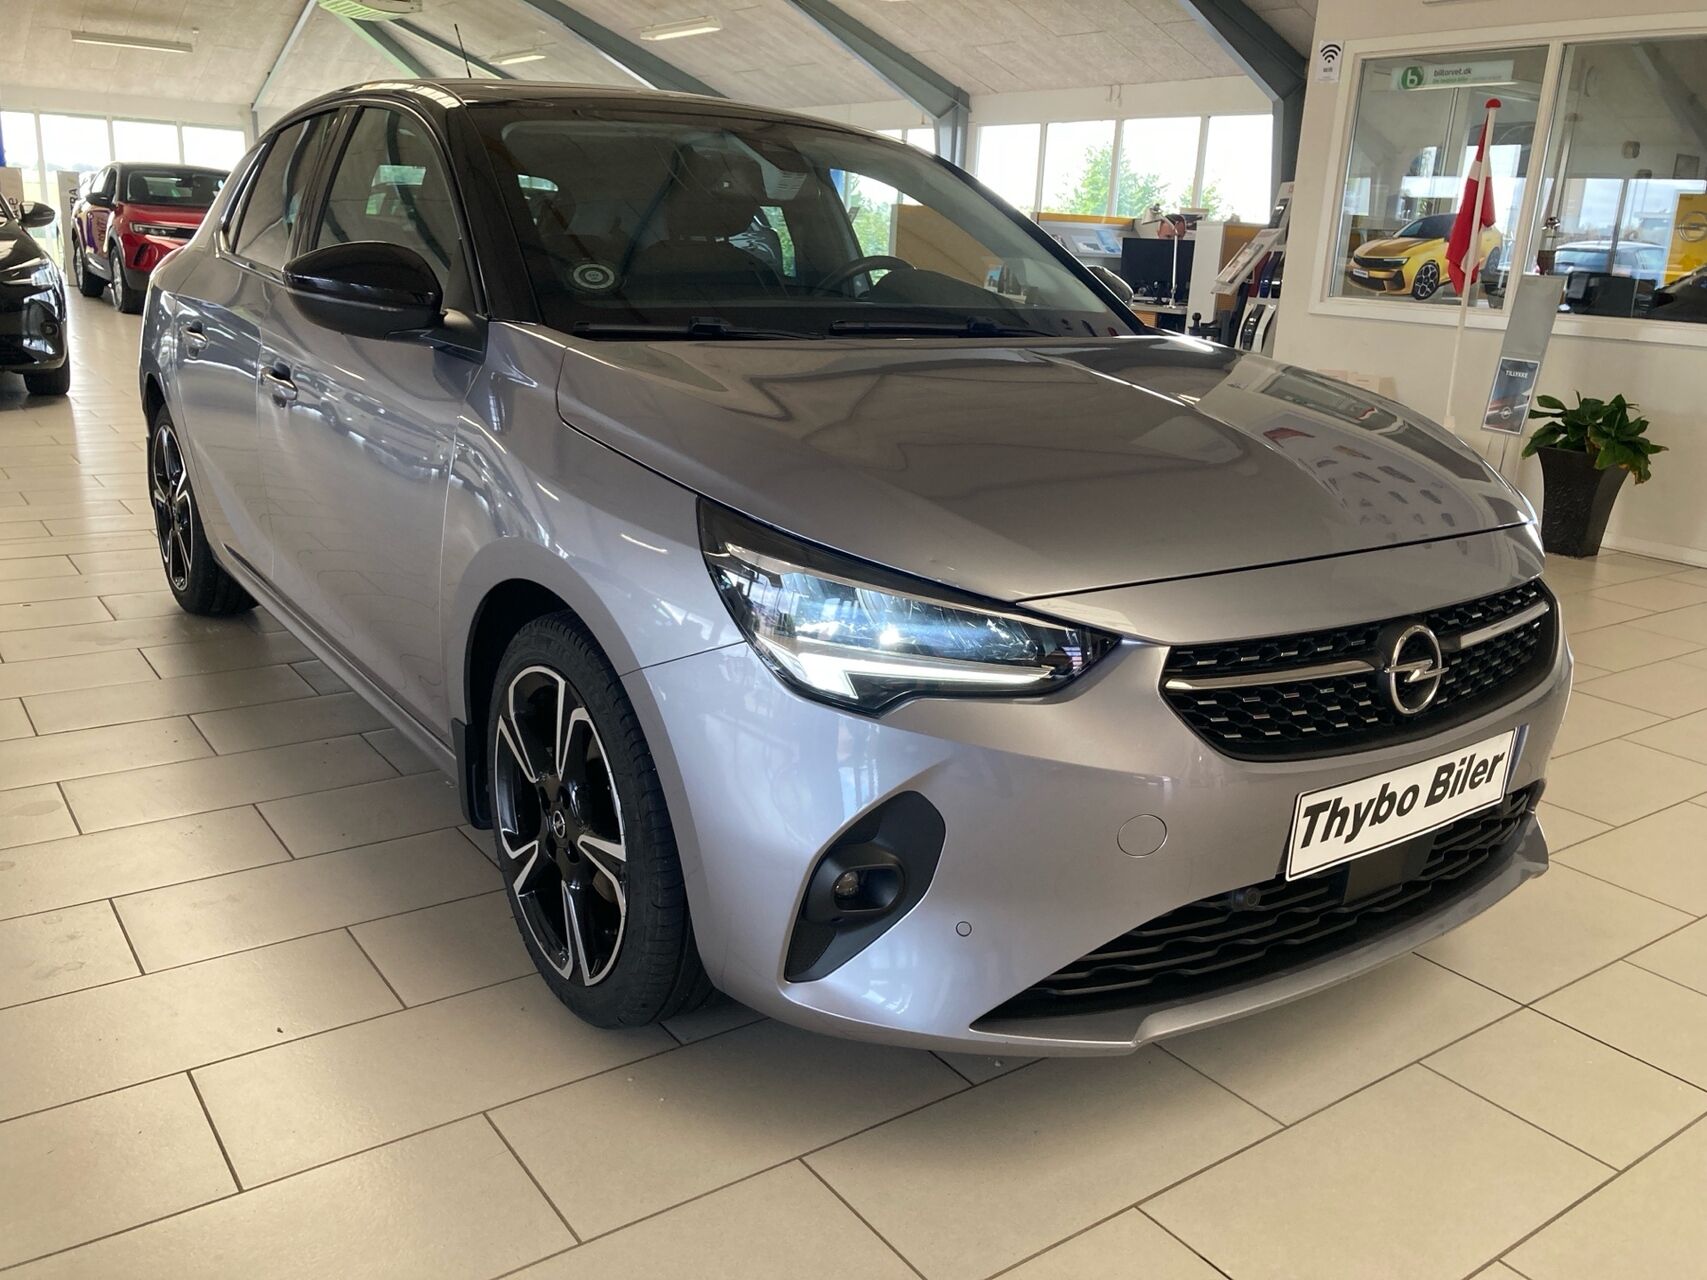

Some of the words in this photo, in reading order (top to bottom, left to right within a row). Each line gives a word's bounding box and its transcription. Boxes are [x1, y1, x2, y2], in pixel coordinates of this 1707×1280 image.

[1505, 370, 1528, 379] TILLYKKE
[1301, 782, 1420, 849] Thybo
[1424, 751, 1506, 808] Biler
